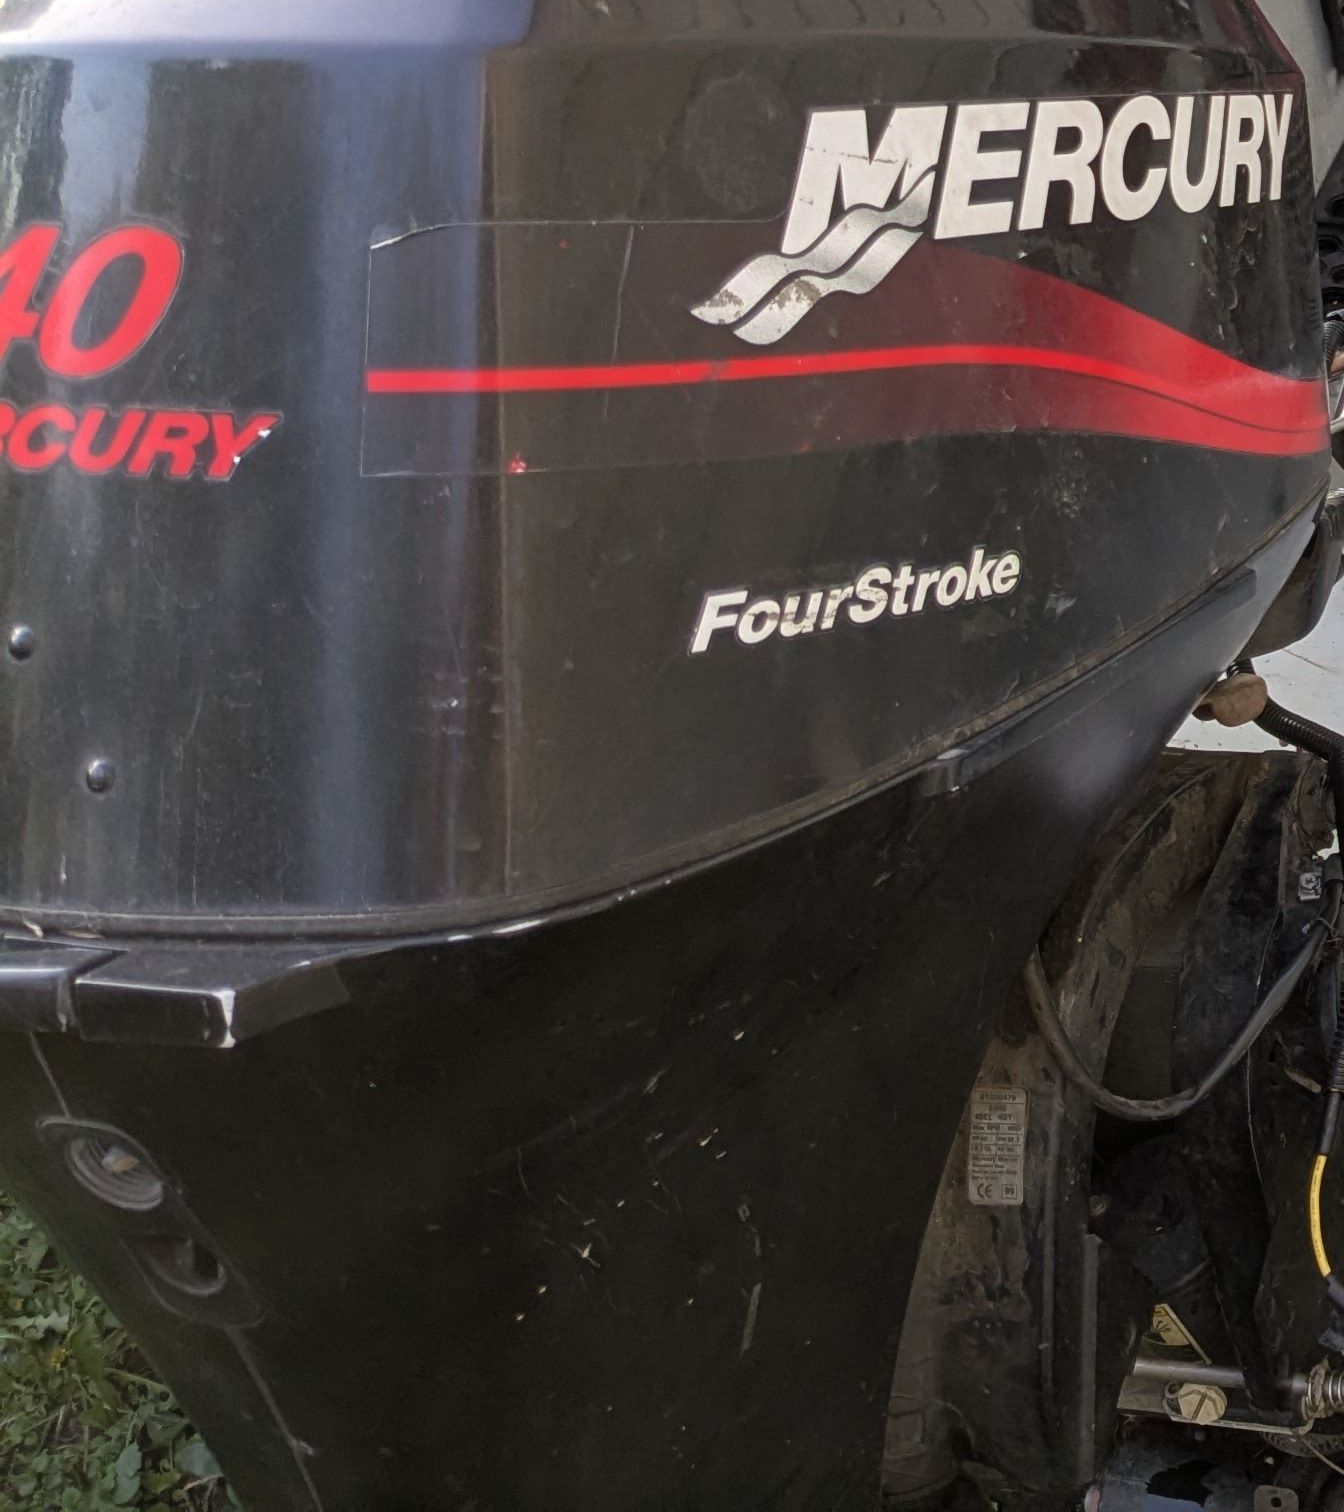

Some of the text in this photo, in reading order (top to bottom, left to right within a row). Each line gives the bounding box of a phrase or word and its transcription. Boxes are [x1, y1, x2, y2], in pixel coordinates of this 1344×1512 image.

[781, 94, 1293, 254] MERCURY
[0, 402, 281, 478] CURY
[691, 549, 1021, 654] FourStroke
